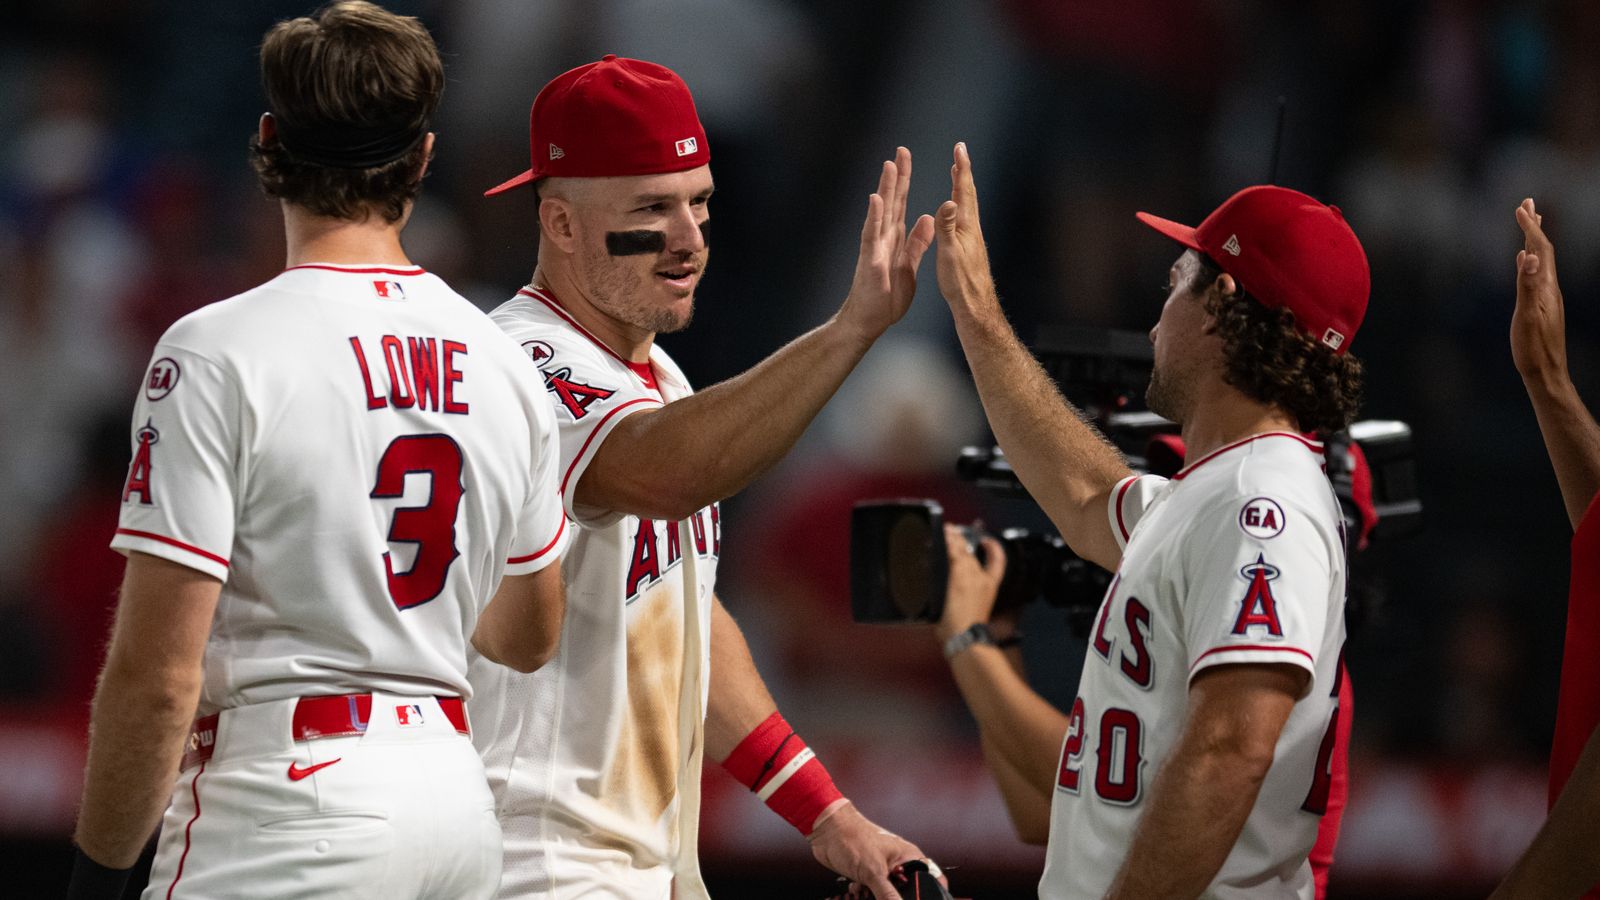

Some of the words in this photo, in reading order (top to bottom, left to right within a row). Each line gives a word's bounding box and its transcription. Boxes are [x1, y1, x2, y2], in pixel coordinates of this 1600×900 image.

[349, 335, 468, 415] LOWE
[370, 433, 465, 612] 3
[1245, 507, 1278, 530] GA
[1231, 552, 1283, 637] A
[1057, 696, 1144, 804] 20
